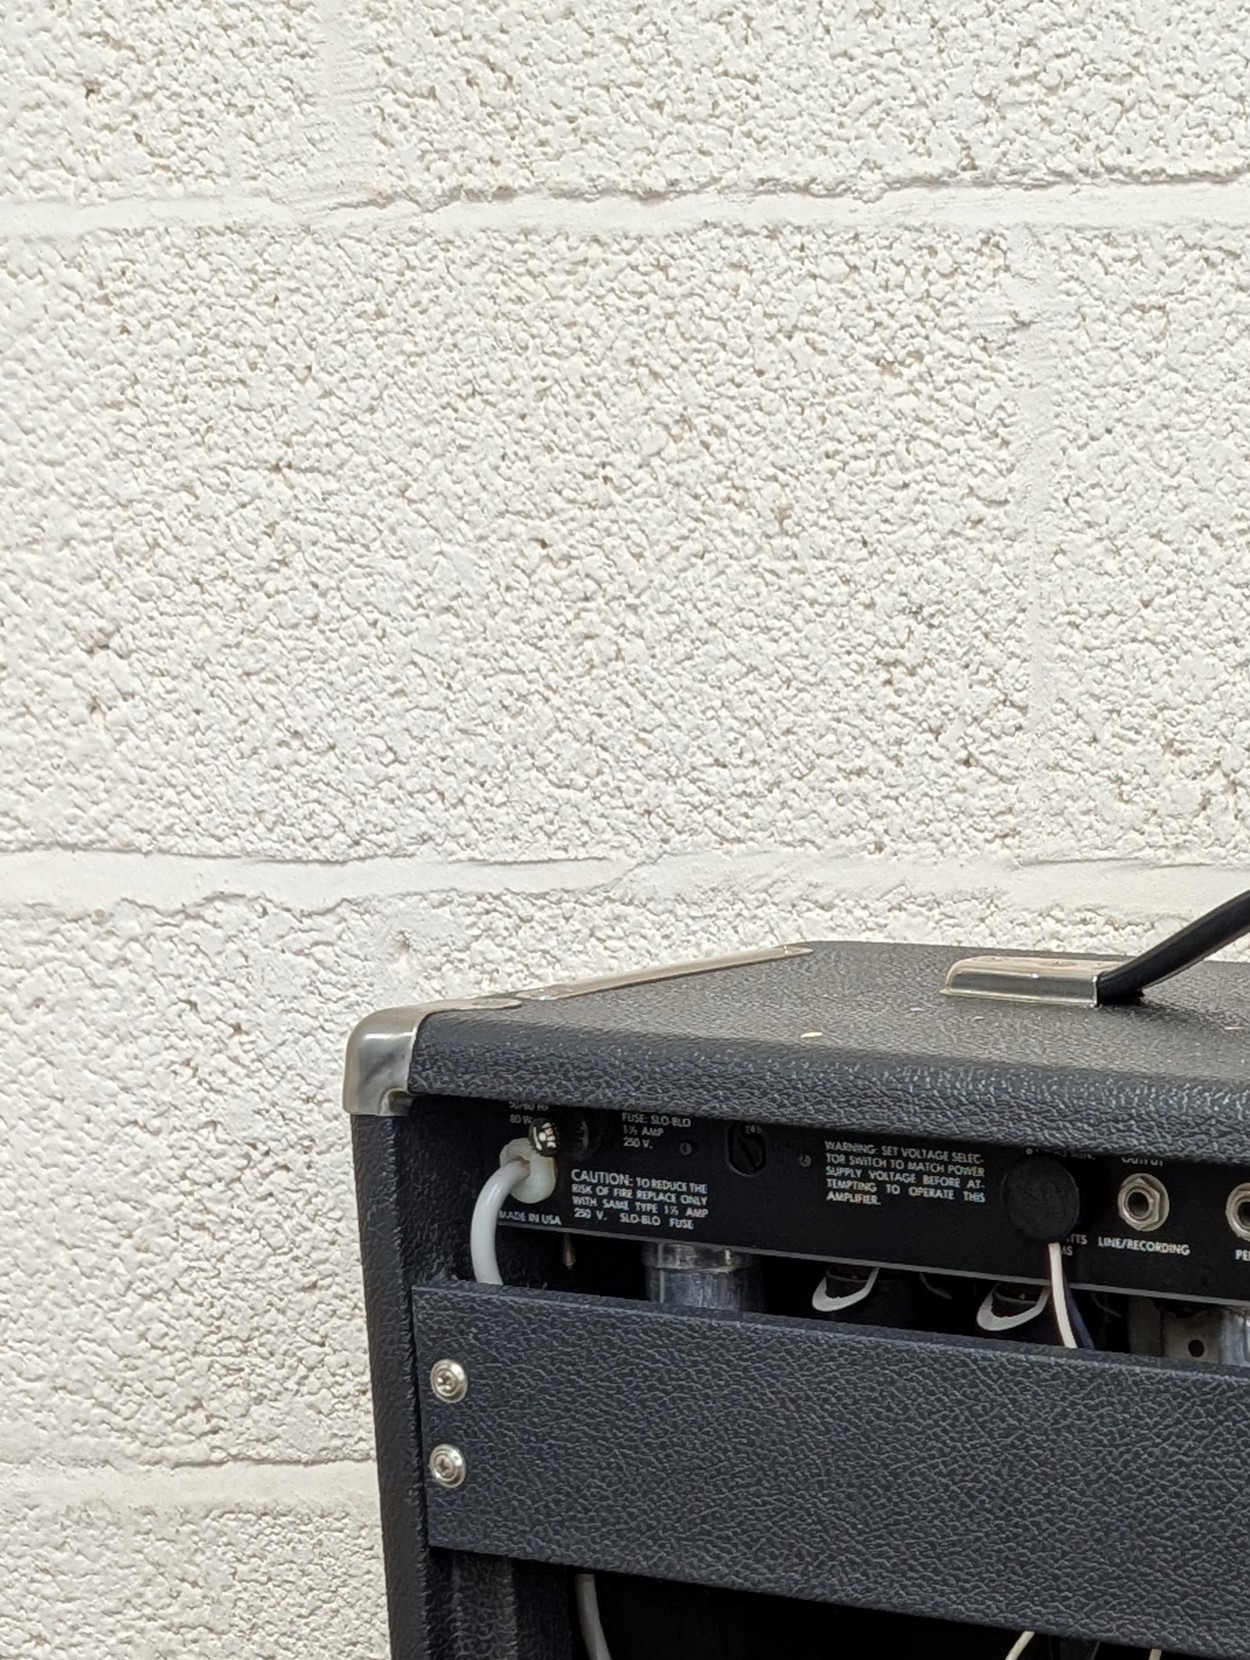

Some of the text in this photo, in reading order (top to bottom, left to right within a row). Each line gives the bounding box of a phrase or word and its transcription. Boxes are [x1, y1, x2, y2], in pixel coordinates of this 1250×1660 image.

[623, 1137, 640, 1147] 250
[641, 1127, 664, 1136] AMP
[824, 1141, 984, 1164] WARNING: SET VOLTAGE SELEC-
[826, 1153, 985, 1177] TOR SWITCH TO MATCH POWER
[571, 1169, 707, 1194] CAUTION: TO REDUCE THE
[825, 1166, 986, 1189] SUPPLY VOLTAGE BEFORE AT-
[572, 1184, 708, 1206] RISK OF FIRE REPLACE ONLY
[826, 1178, 986, 1202] TEMPTING TO OPERATE THIS
[826, 1191, 881, 1206] AMPLIFIER.
[572, 1196, 598, 1207] WITH
[602, 1199, 629, 1211] SAME
[635, 1202, 658, 1213] TYPE
[685, 1208, 709, 1218] AMP
[529, 1213, 540, 1223] IN
[541, 1214, 562, 1226] USA
[574, 1208, 592, 1219] 250
[620, 1212, 661, 1226] SLO-BLO
[669, 1218, 694, 1230] FUSE
[1097, 1236, 1191, 1256] LINE/RECORDING
